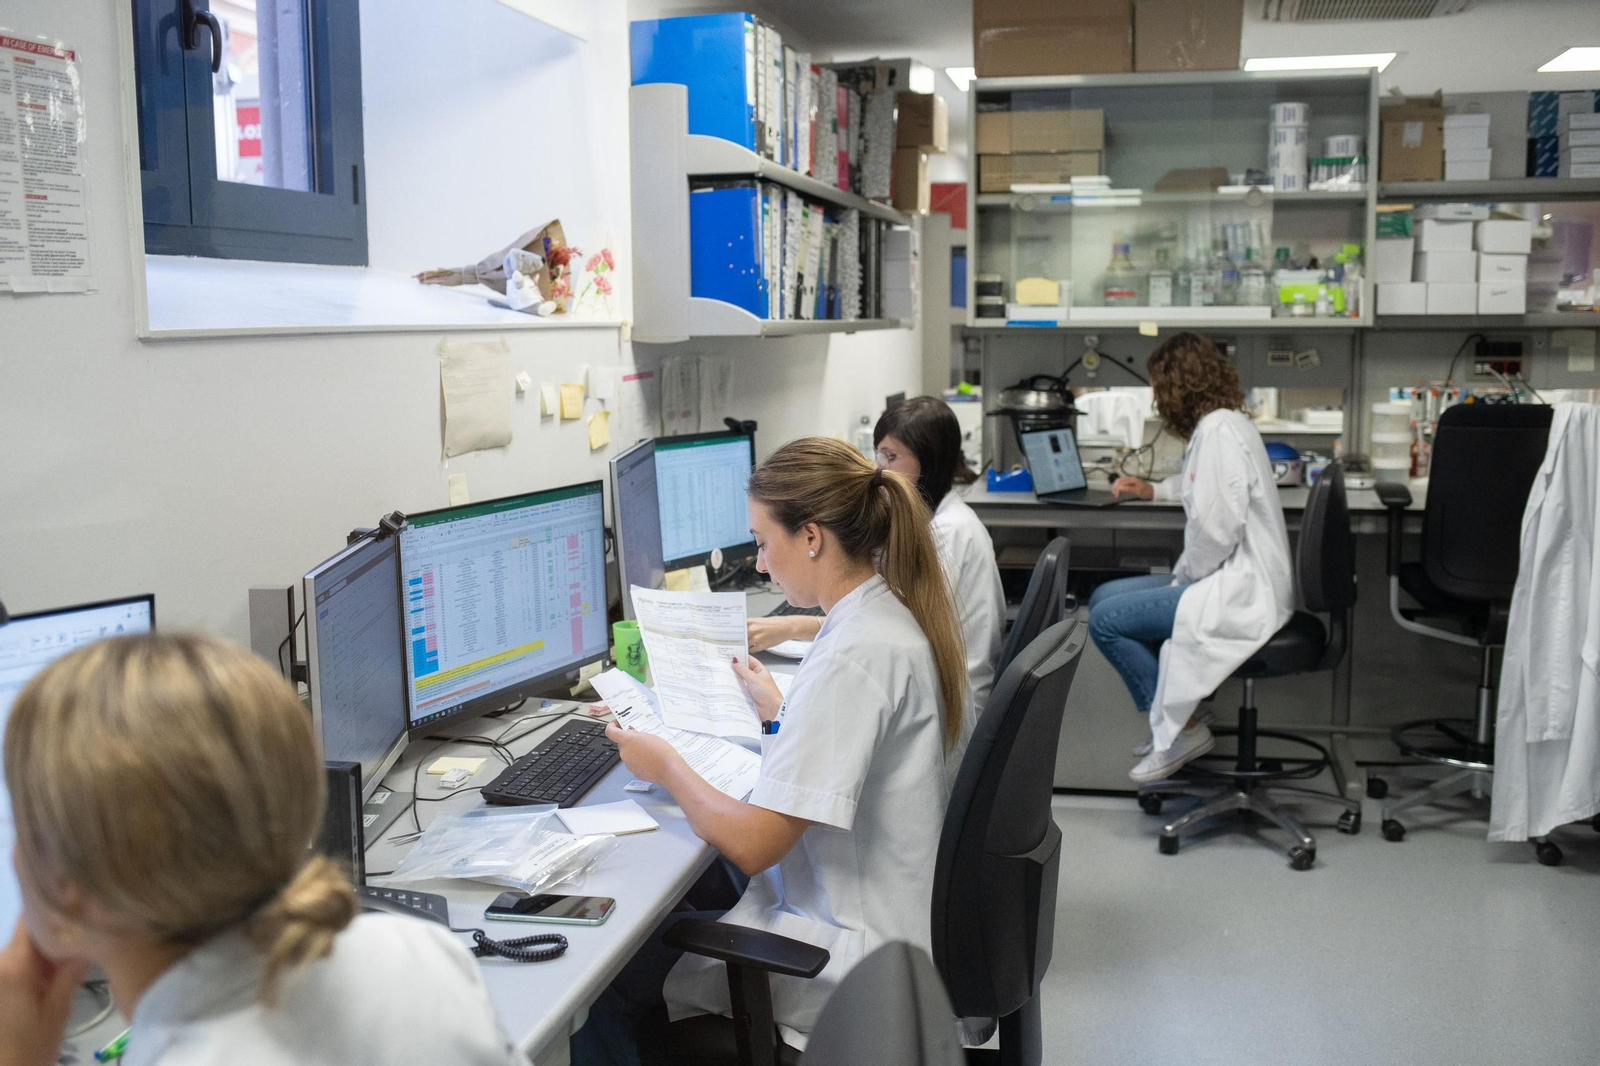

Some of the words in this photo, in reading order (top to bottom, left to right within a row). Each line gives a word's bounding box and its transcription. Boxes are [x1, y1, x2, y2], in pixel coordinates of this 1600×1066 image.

[2, 38, 9, 46] IN
[10, 40, 27, 50] CASE
[28, 43, 36, 51] OF
[37, 46, 73, 58] EMERY
